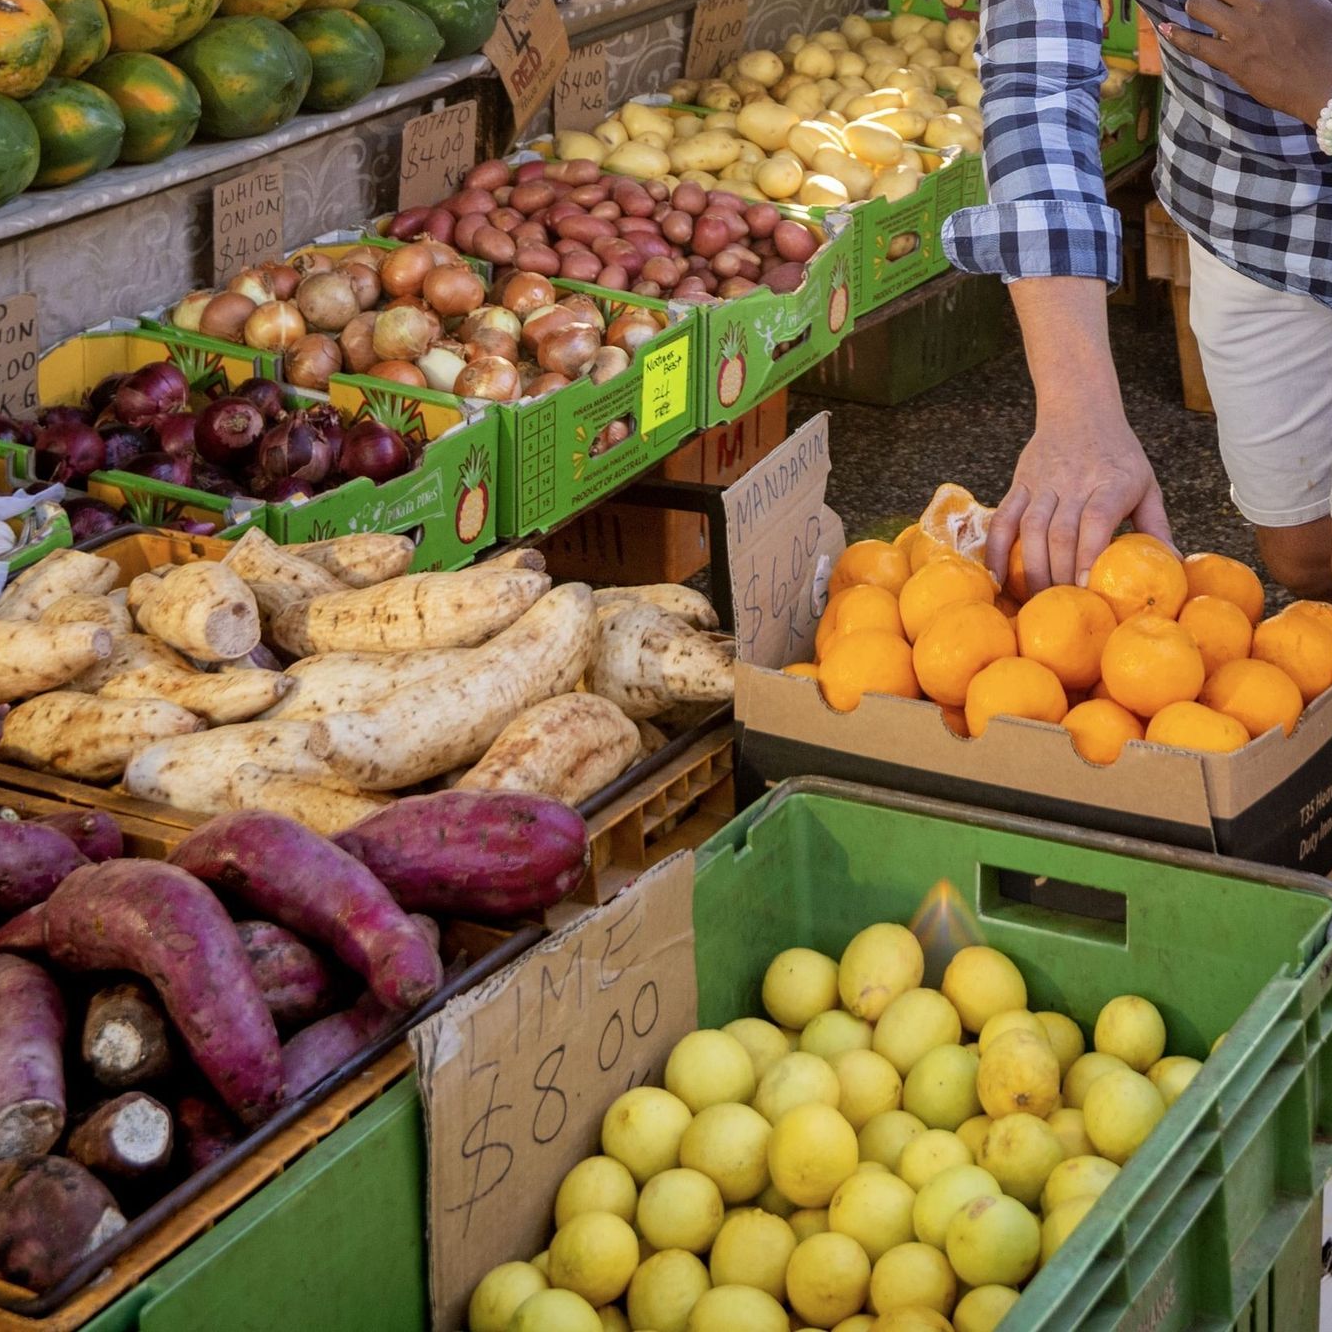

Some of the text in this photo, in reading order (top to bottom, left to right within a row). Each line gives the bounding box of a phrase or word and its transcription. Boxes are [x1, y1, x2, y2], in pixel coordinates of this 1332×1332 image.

[510, 46, 542, 98] RED
[410, 106, 470, 145] POTATO
[220, 173, 279, 207] WHITE
[220, 197, 280, 234] ONION
[215, 228, 277, 279] $4.00
[571, 452, 648, 506] PRODUCT OF AUSTRALIA
[736, 428, 826, 543] MANDARIN
[743, 516, 821, 660] $6.00
[1299, 830, 1319, 861] Duty
[469, 897, 643, 1080] LIME
